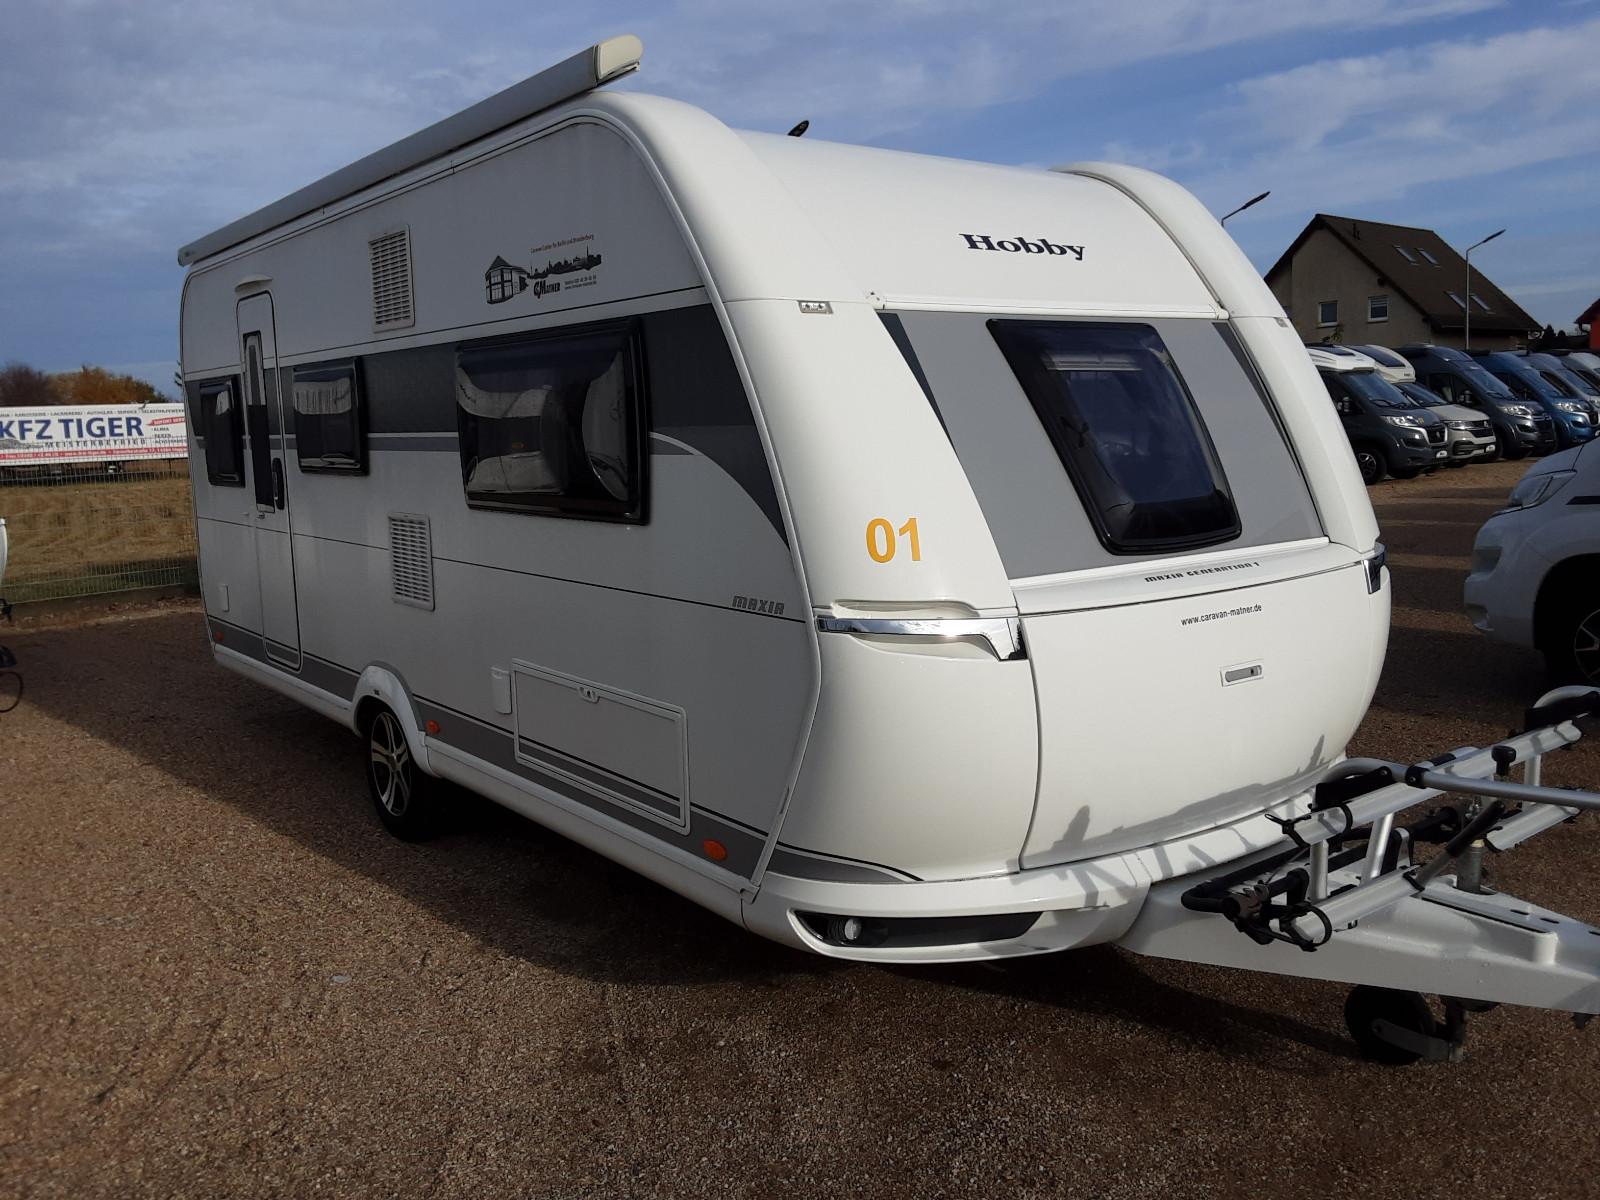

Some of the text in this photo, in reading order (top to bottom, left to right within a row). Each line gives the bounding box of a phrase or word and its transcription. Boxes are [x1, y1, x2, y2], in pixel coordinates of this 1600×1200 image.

[958, 233, 1085, 261] Hobby
[0, 416, 144, 440] KFZ TIGER
[866, 517, 921, 563] 01
[1144, 572, 1184, 582] MAXIA
[1186, 562, 1252, 576] GENERATION
[732, 595, 785, 615] MAXIA
[1181, 603, 1262, 626] www.caravan-matner.de
